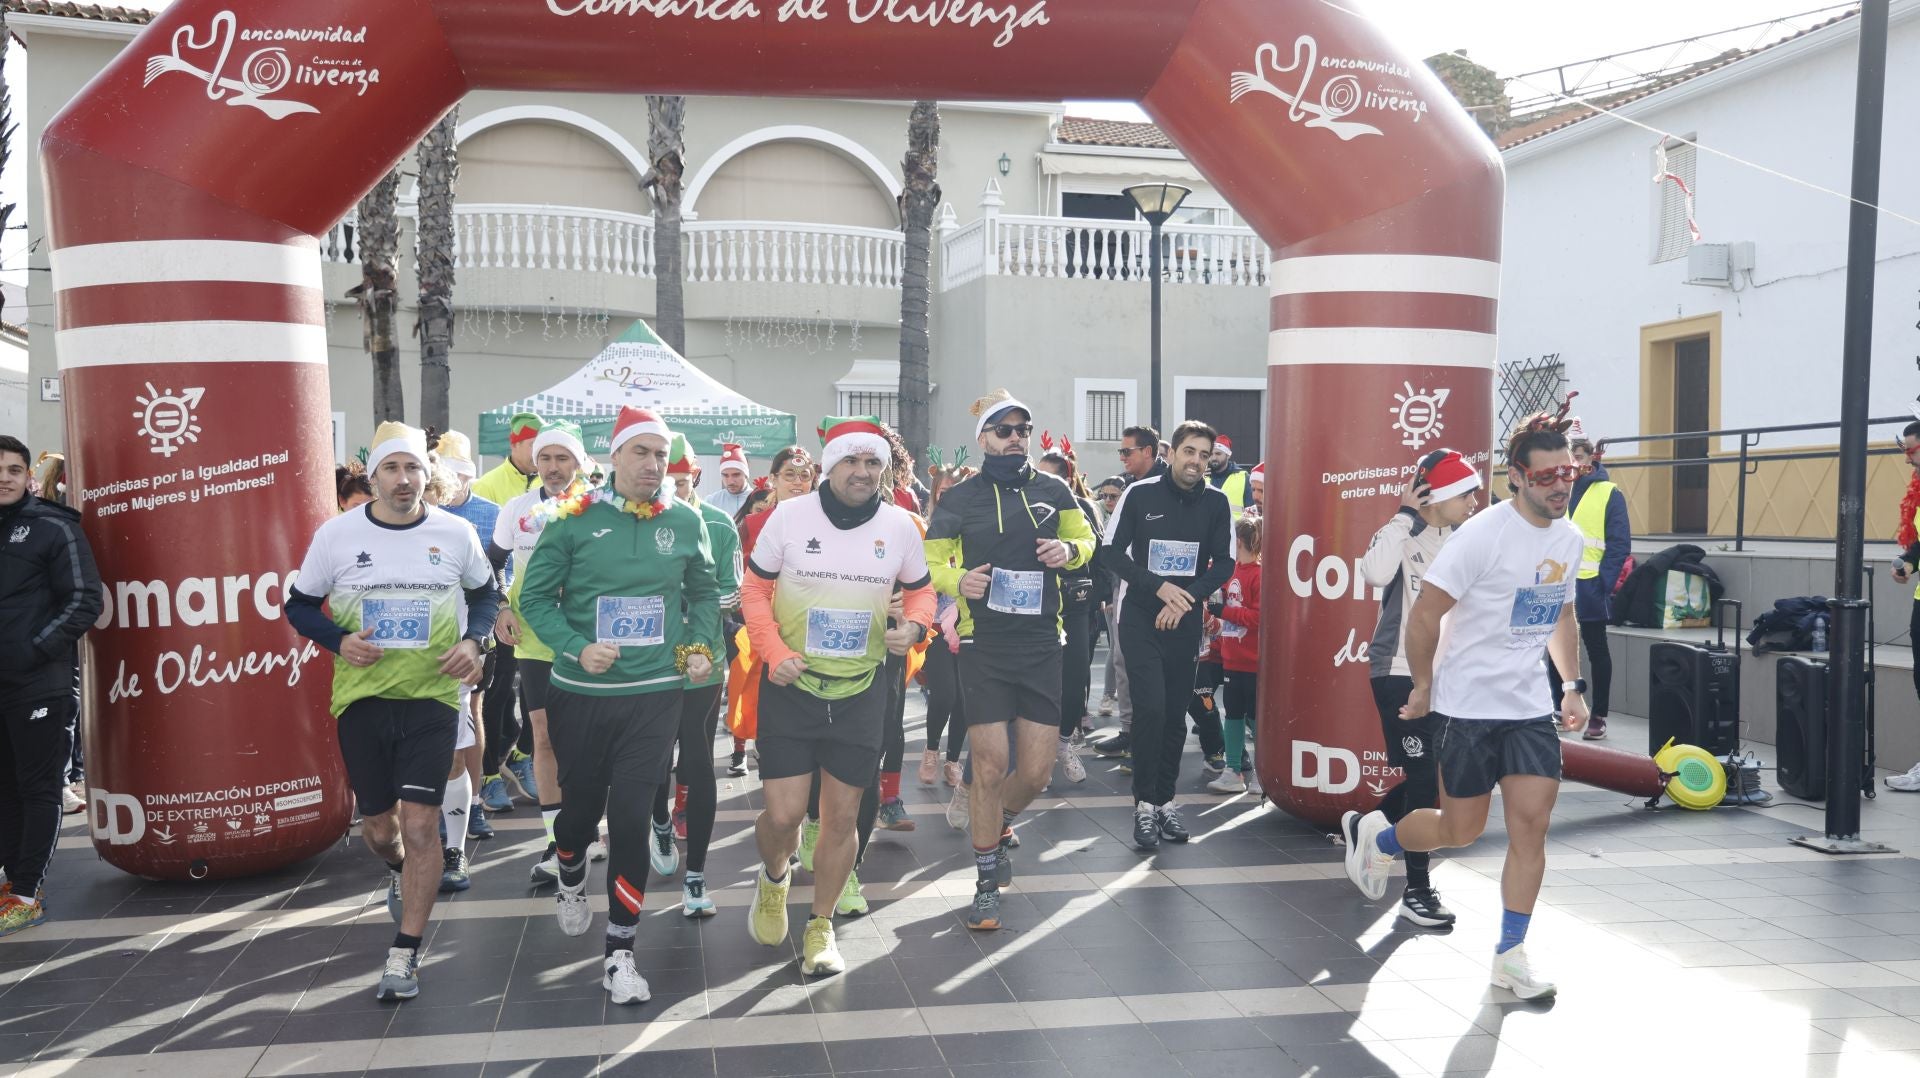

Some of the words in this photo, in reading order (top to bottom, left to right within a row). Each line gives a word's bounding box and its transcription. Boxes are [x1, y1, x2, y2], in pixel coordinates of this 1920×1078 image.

[777, 0, 828, 22] de
[847, 0, 1050, 48] Olivenza
[312, 56, 350, 66] Comarca
[351, 58, 363, 66] de
[663, 416, 714, 426] COMARCA
[716, 418, 729, 426] DE
[731, 417, 780, 426] OLIVENZA
[81, 476, 149, 502] Deportistas
[152, 471, 178, 489] por
[182, 467, 194, 482] la
[198, 457, 259, 481] Igualdad
[262, 449, 289, 467] Real
[1322, 465, 1398, 485] Deportistas
[1400, 464, 1418, 479] po
[97, 500, 128, 517] entre
[132, 490, 186, 511] Mujeres
[190, 489, 201, 502] y
[204, 472, 275, 497] Hombres!!
[1341, 485, 1376, 500] entre
[796, 569, 838, 580] RUNNERS
[1160, 556, 1190, 571] 59
[352, 583, 392, 592] RUNNERS
[394, 582, 450, 591] VALVERDEÑOS
[1010, 590, 1029, 607] 3
[1526, 602, 1559, 625] 31
[374, 618, 420, 640] 88
[611, 616, 655, 638] 64
[821, 629, 862, 650] 35
[1334, 628, 1370, 667] de
[109, 659, 142, 704] de
[155, 640, 320, 694] Olivenza
[1292, 739, 1361, 794] DD
[1363, 750, 1388, 761] DIN
[1363, 765, 1379, 776] DE
[1382, 766, 1406, 777] EXT
[146, 785, 252, 806] DINAMIZACIÓN
[255, 775, 322, 797] DEPORTIVA
[89, 788, 146, 845] DD
[147, 810, 164, 822] DE
[168, 800, 273, 821] EXTREMADURA
